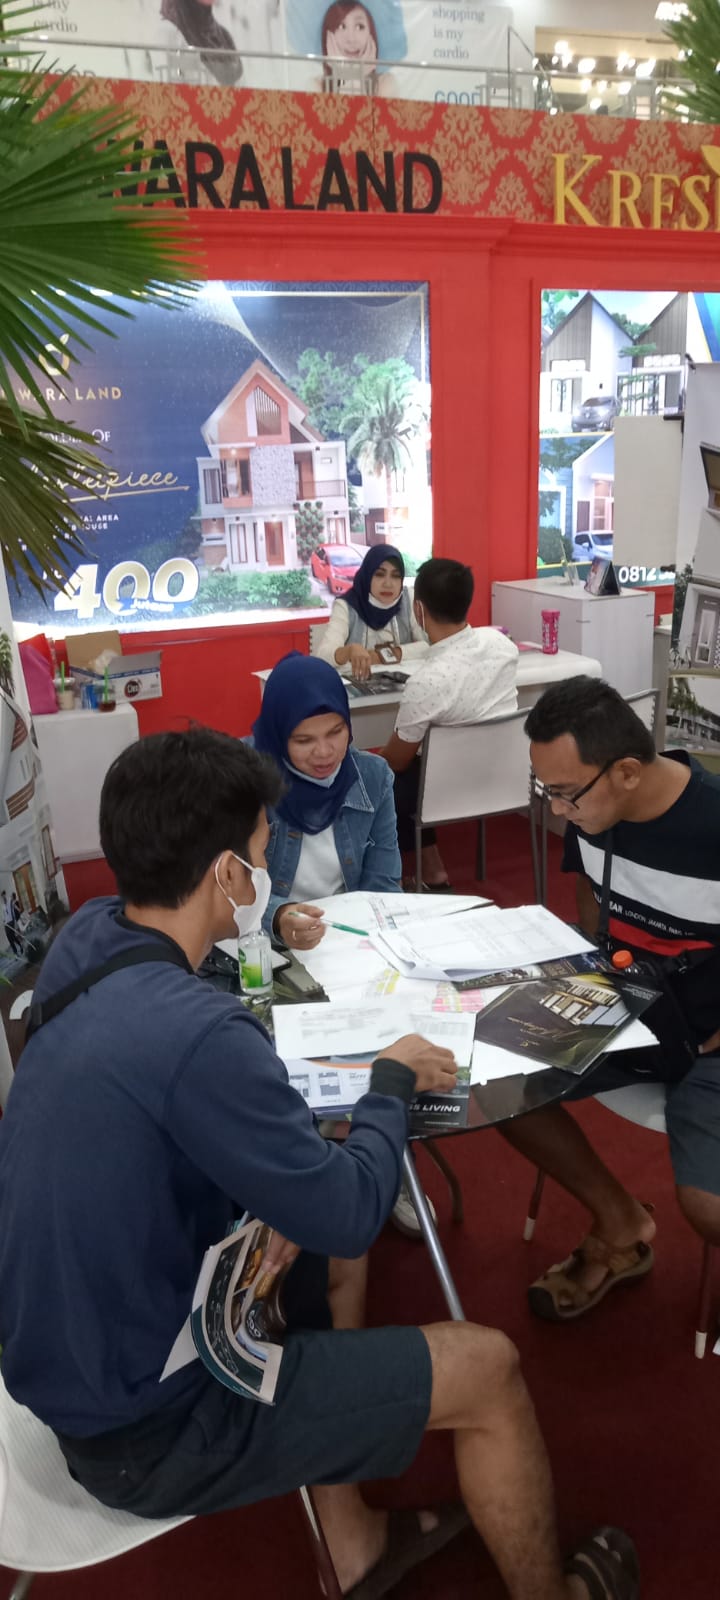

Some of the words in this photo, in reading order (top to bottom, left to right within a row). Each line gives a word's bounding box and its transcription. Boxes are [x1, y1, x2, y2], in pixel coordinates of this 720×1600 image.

[432, 4, 485, 23] shopping
[433, 24, 443, 38] is
[446, 30, 464, 42] my
[433, 45, 470, 60] cardio
[281, 147, 443, 214] LAND
[75, 386, 122, 401] LAND
[53, 557, 200, 619] 400
[422, 1104, 461, 1112] LIVING
